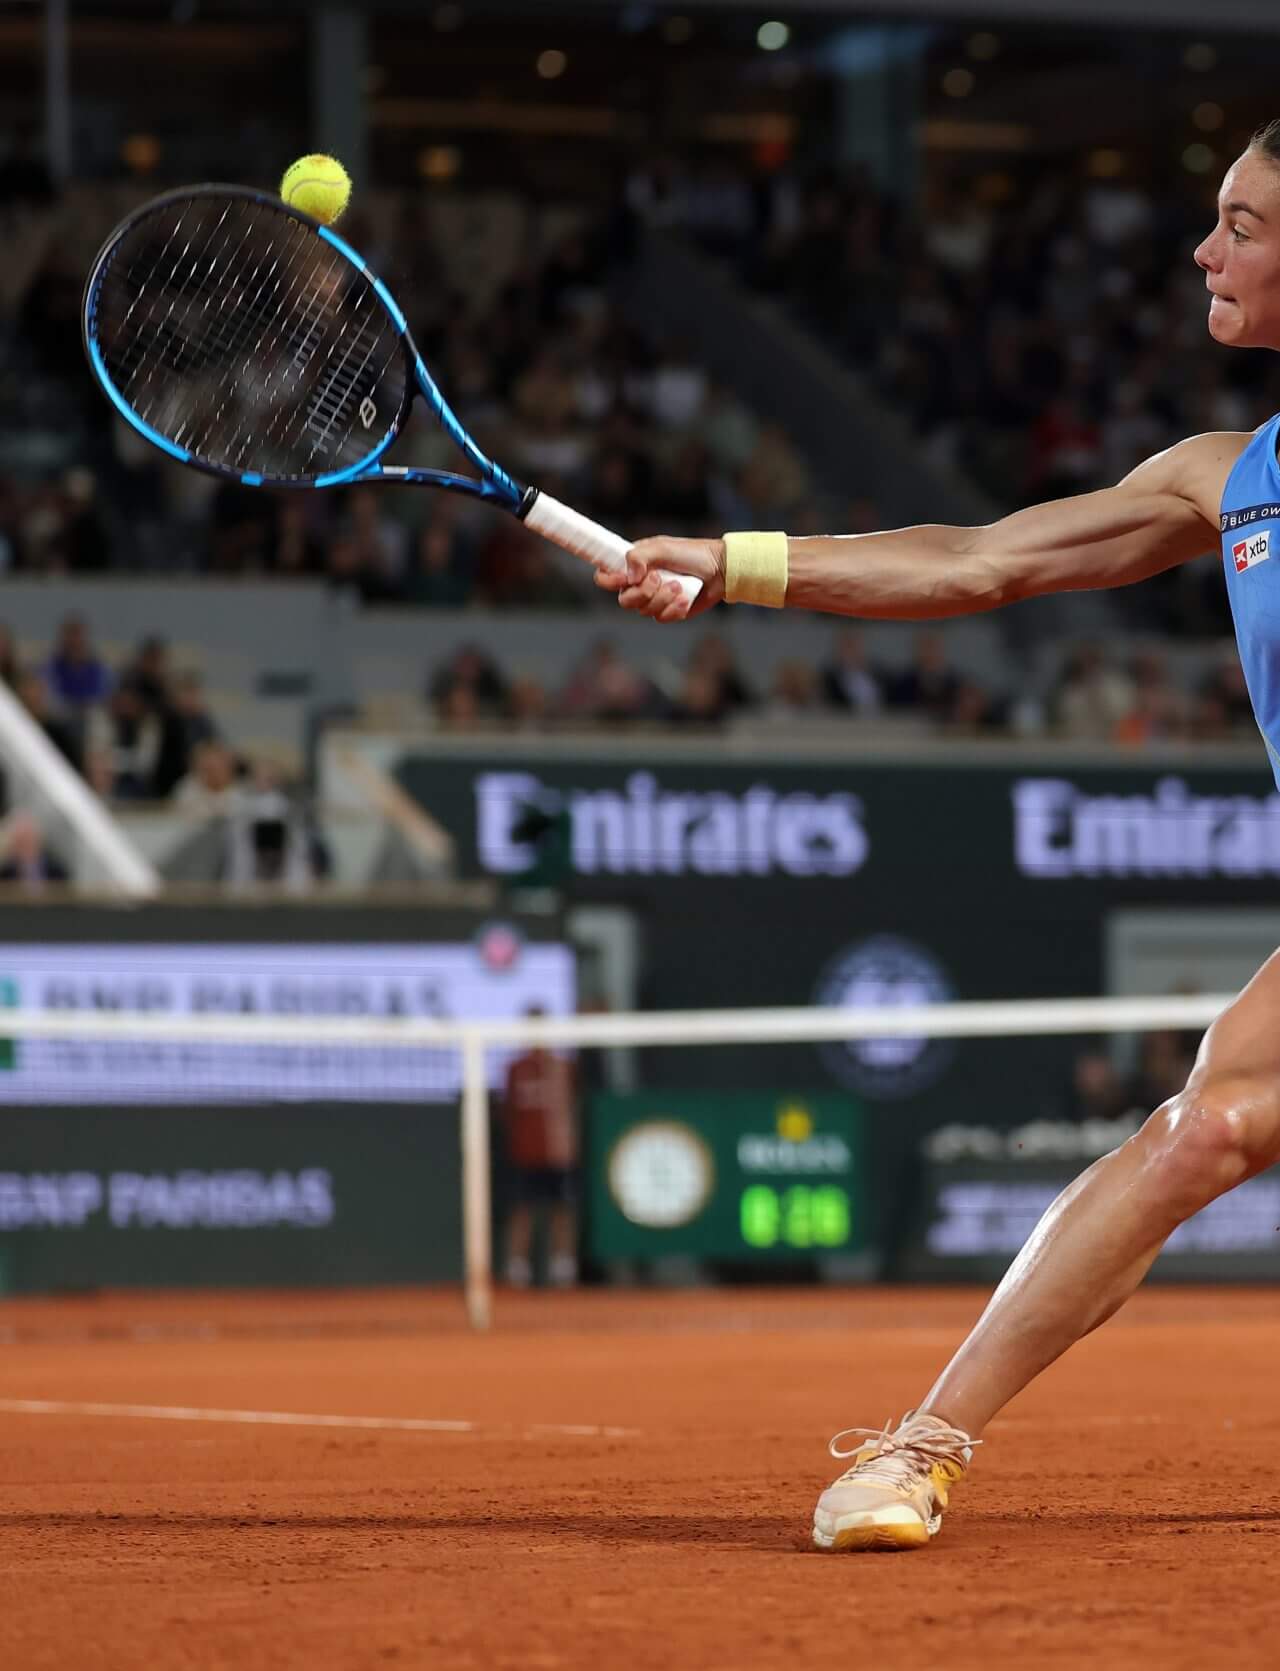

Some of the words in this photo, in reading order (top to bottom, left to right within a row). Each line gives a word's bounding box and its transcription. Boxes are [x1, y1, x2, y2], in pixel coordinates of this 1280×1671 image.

[1230, 510, 1257, 526] BLUE
[1249, 536, 1267, 559] xtb
[476, 771, 869, 877] Emirates
